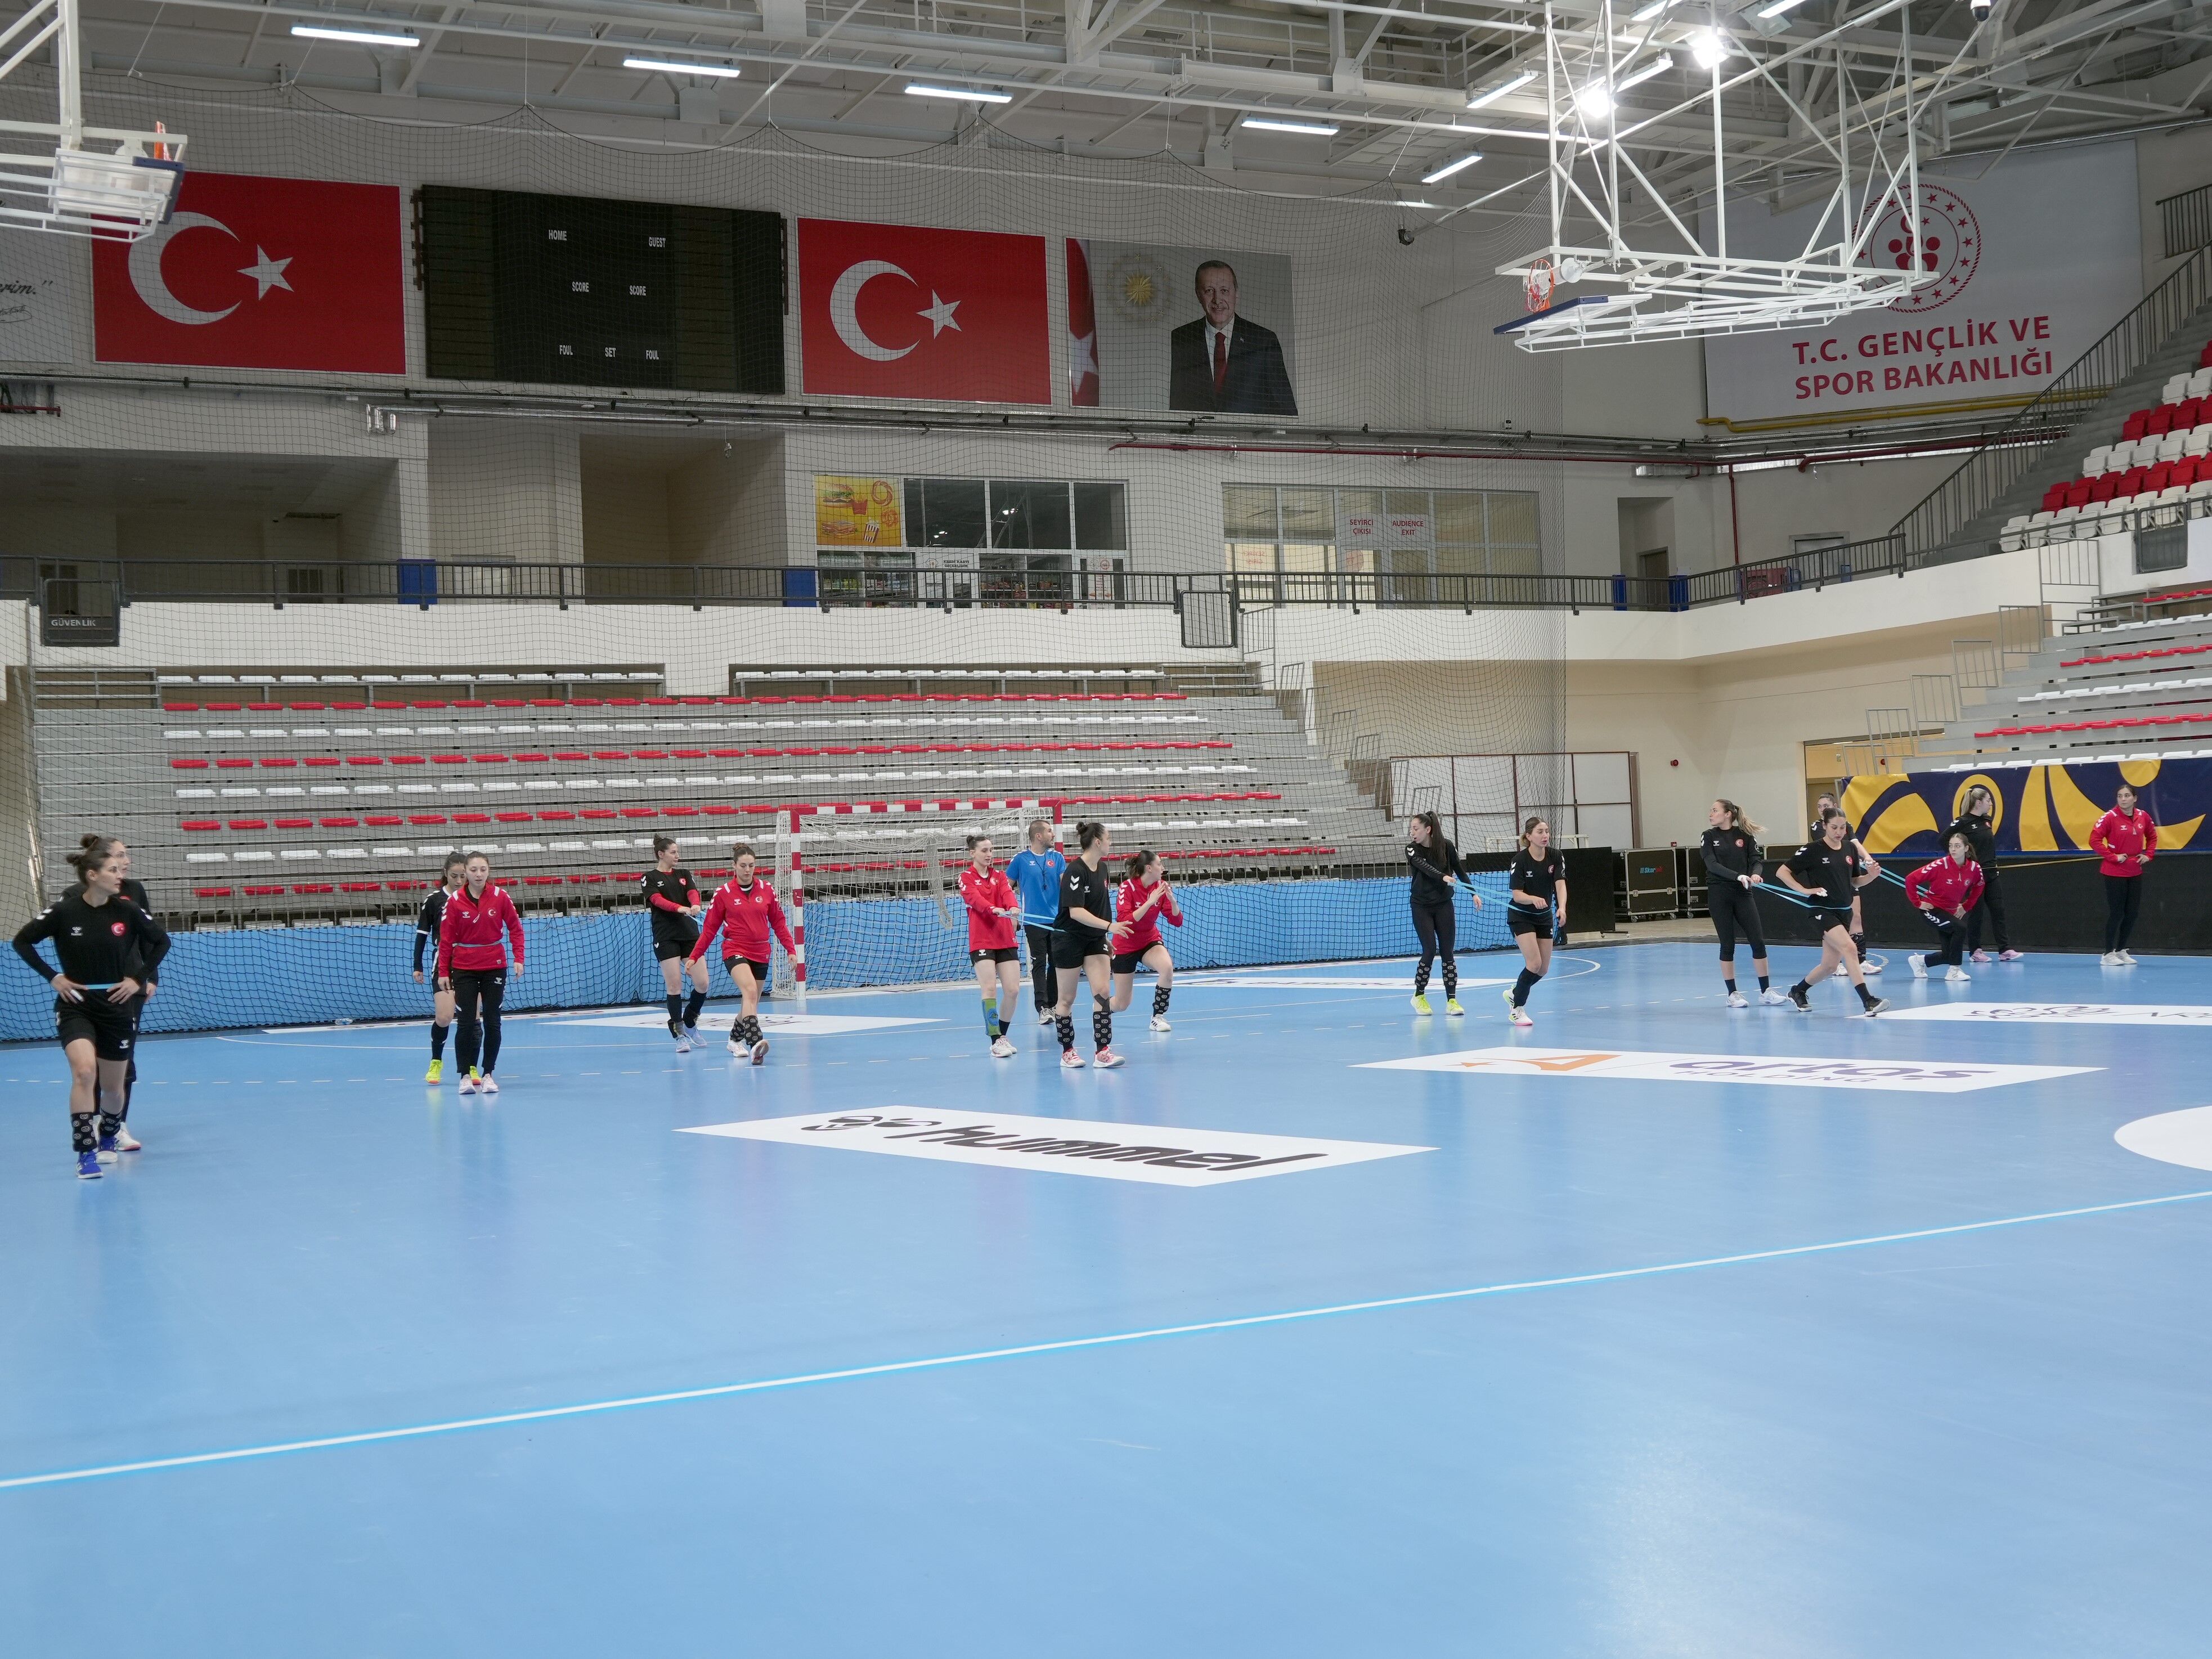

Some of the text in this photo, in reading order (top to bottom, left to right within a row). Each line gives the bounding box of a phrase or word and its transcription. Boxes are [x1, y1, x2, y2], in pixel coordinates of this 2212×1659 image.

[549, 229, 567, 241] HOME
[648, 236, 666, 248] GUEST
[572, 281, 590, 293] SCORE
[629, 285, 647, 296] SCORE
[1792, 315, 2051, 365] T.C. GENÇLİK VE
[559, 344, 573, 356] FOUL
[605, 347, 616, 358] SET
[646, 349, 659, 360] FOUL
[1795, 347, 2053, 400] SPOR BAKANLIĞI
[51, 618, 96, 626] GÜVENLİK
[1668, 1061, 1997, 1080] artaş
[882, 1125, 1329, 1171] hummel
